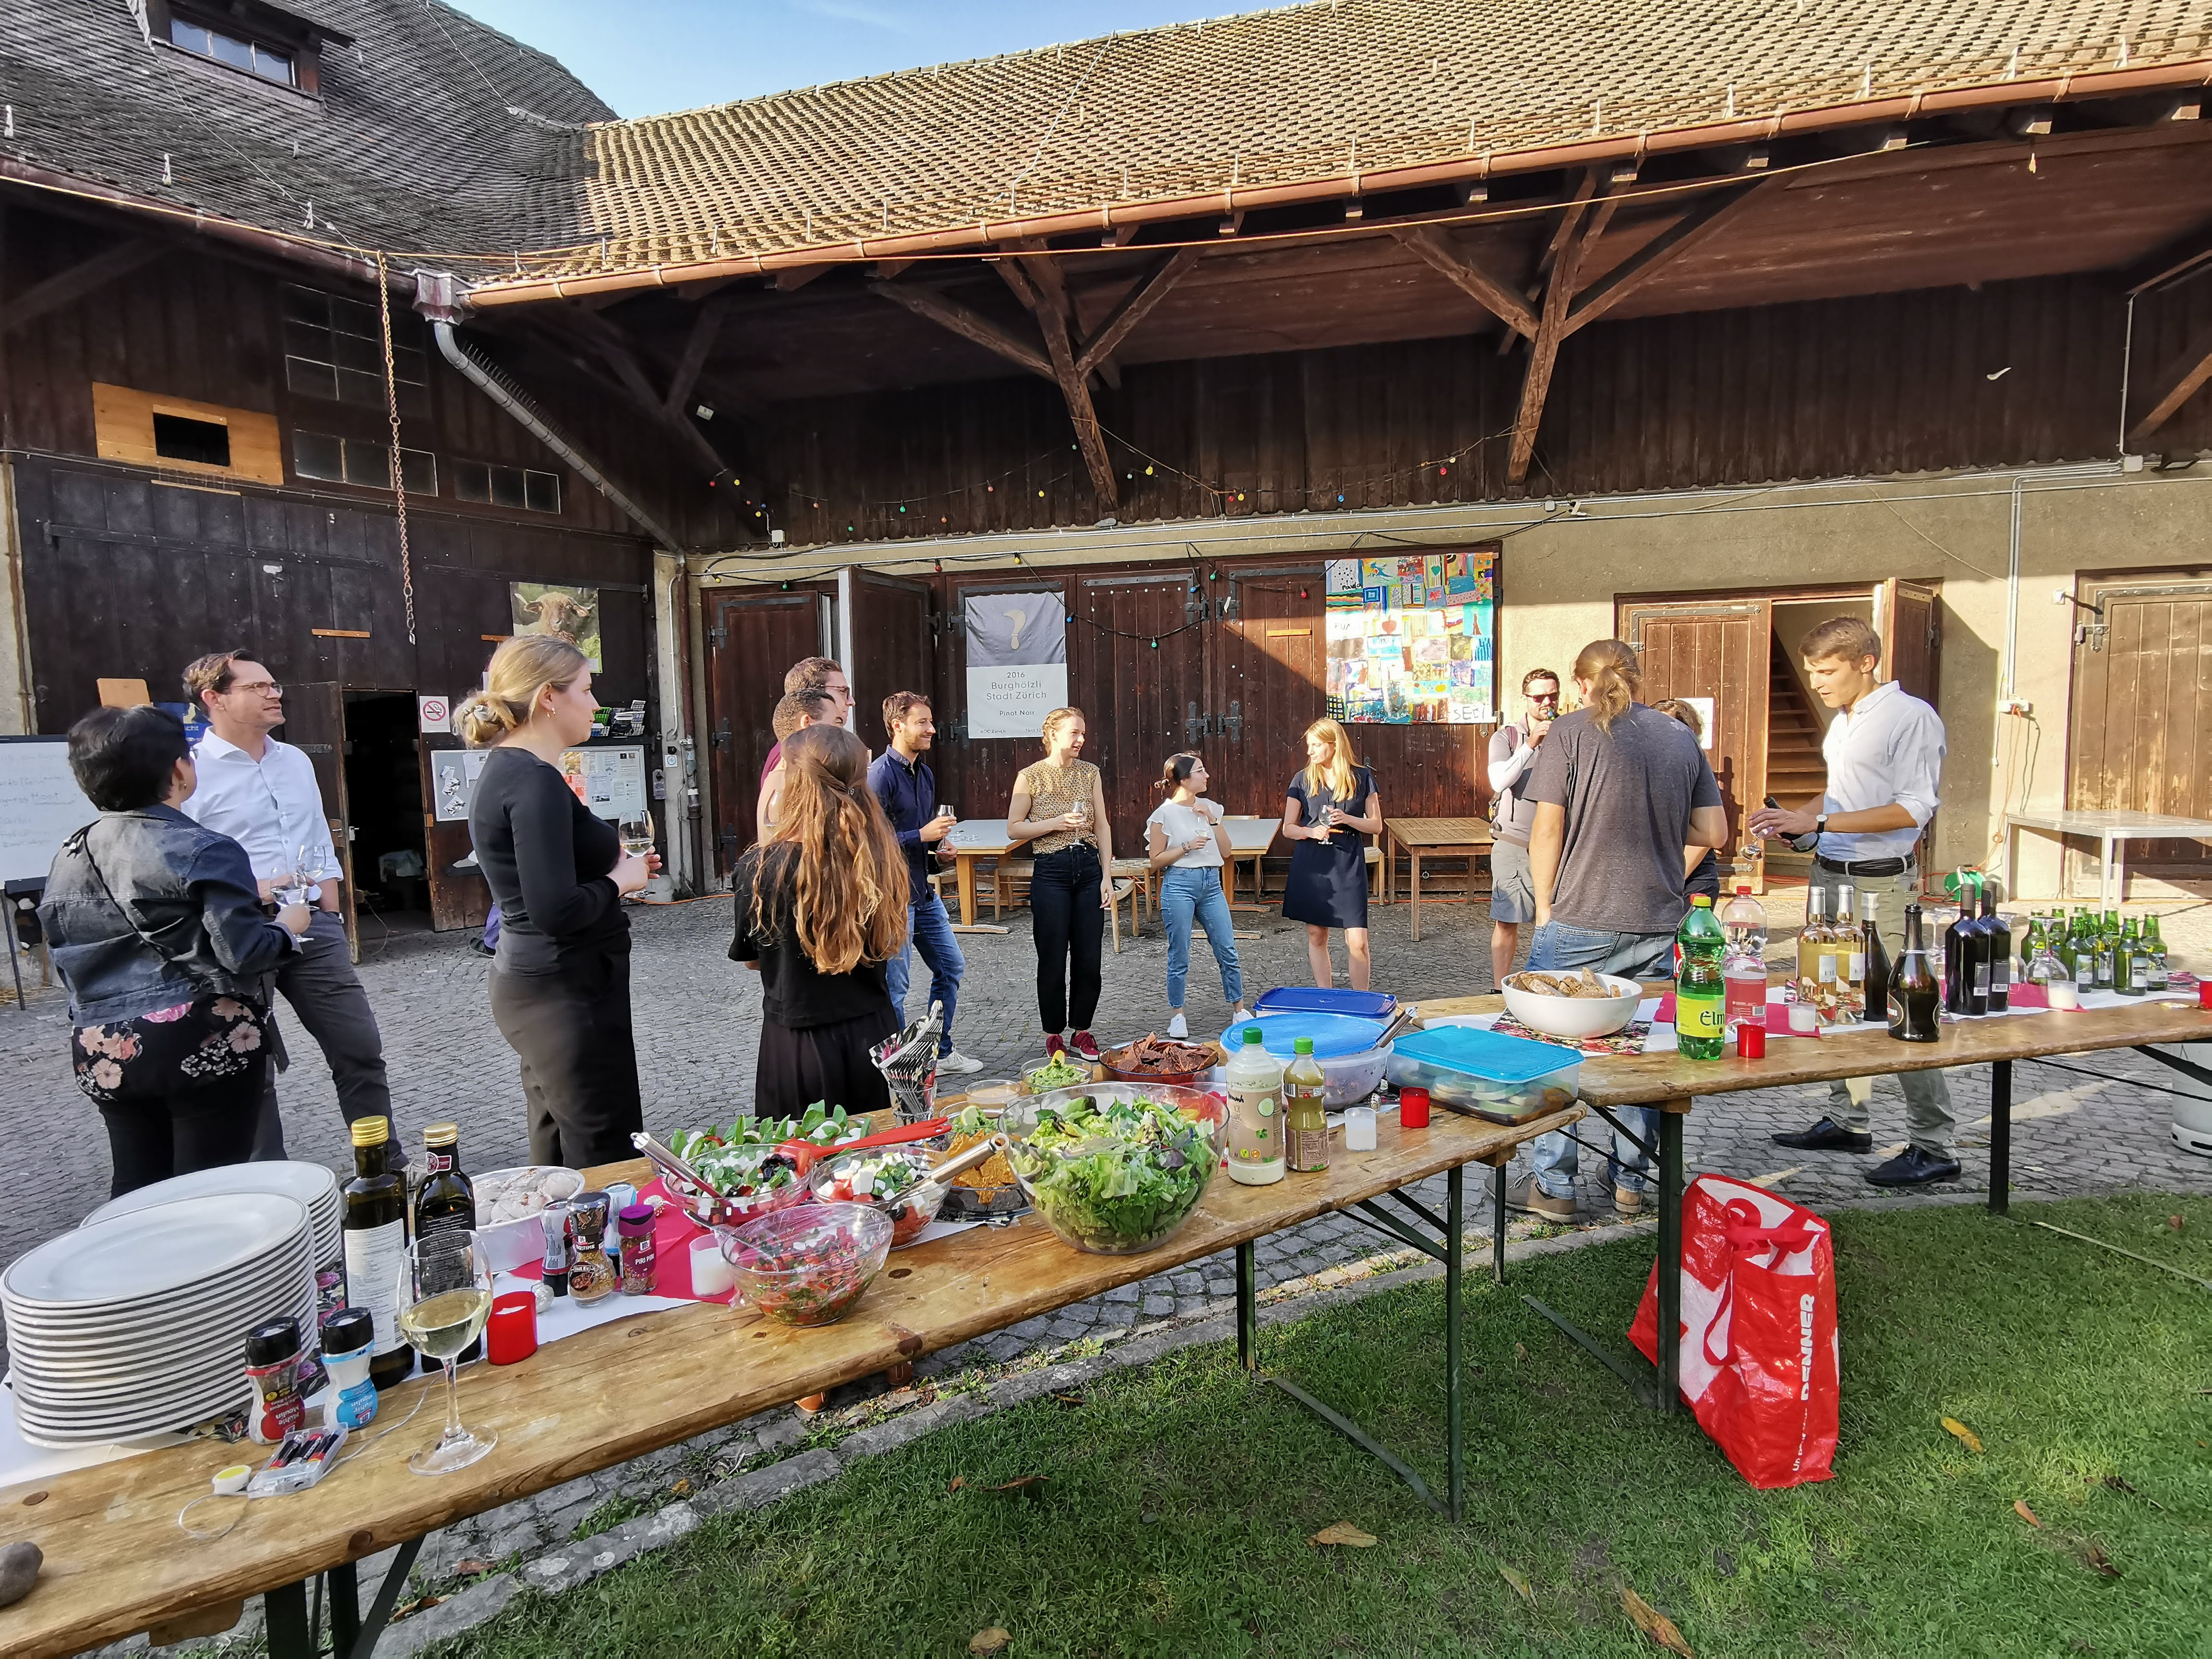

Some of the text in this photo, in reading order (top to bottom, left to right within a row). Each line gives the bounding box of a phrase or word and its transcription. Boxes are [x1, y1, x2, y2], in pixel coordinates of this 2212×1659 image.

[991, 680, 1042, 691] Burghölzli
[986, 691, 1047, 700] Stadt Zürich
[635, 1257, 646, 1265] PIRI
[1800, 1294, 1815, 1401] DENNER
